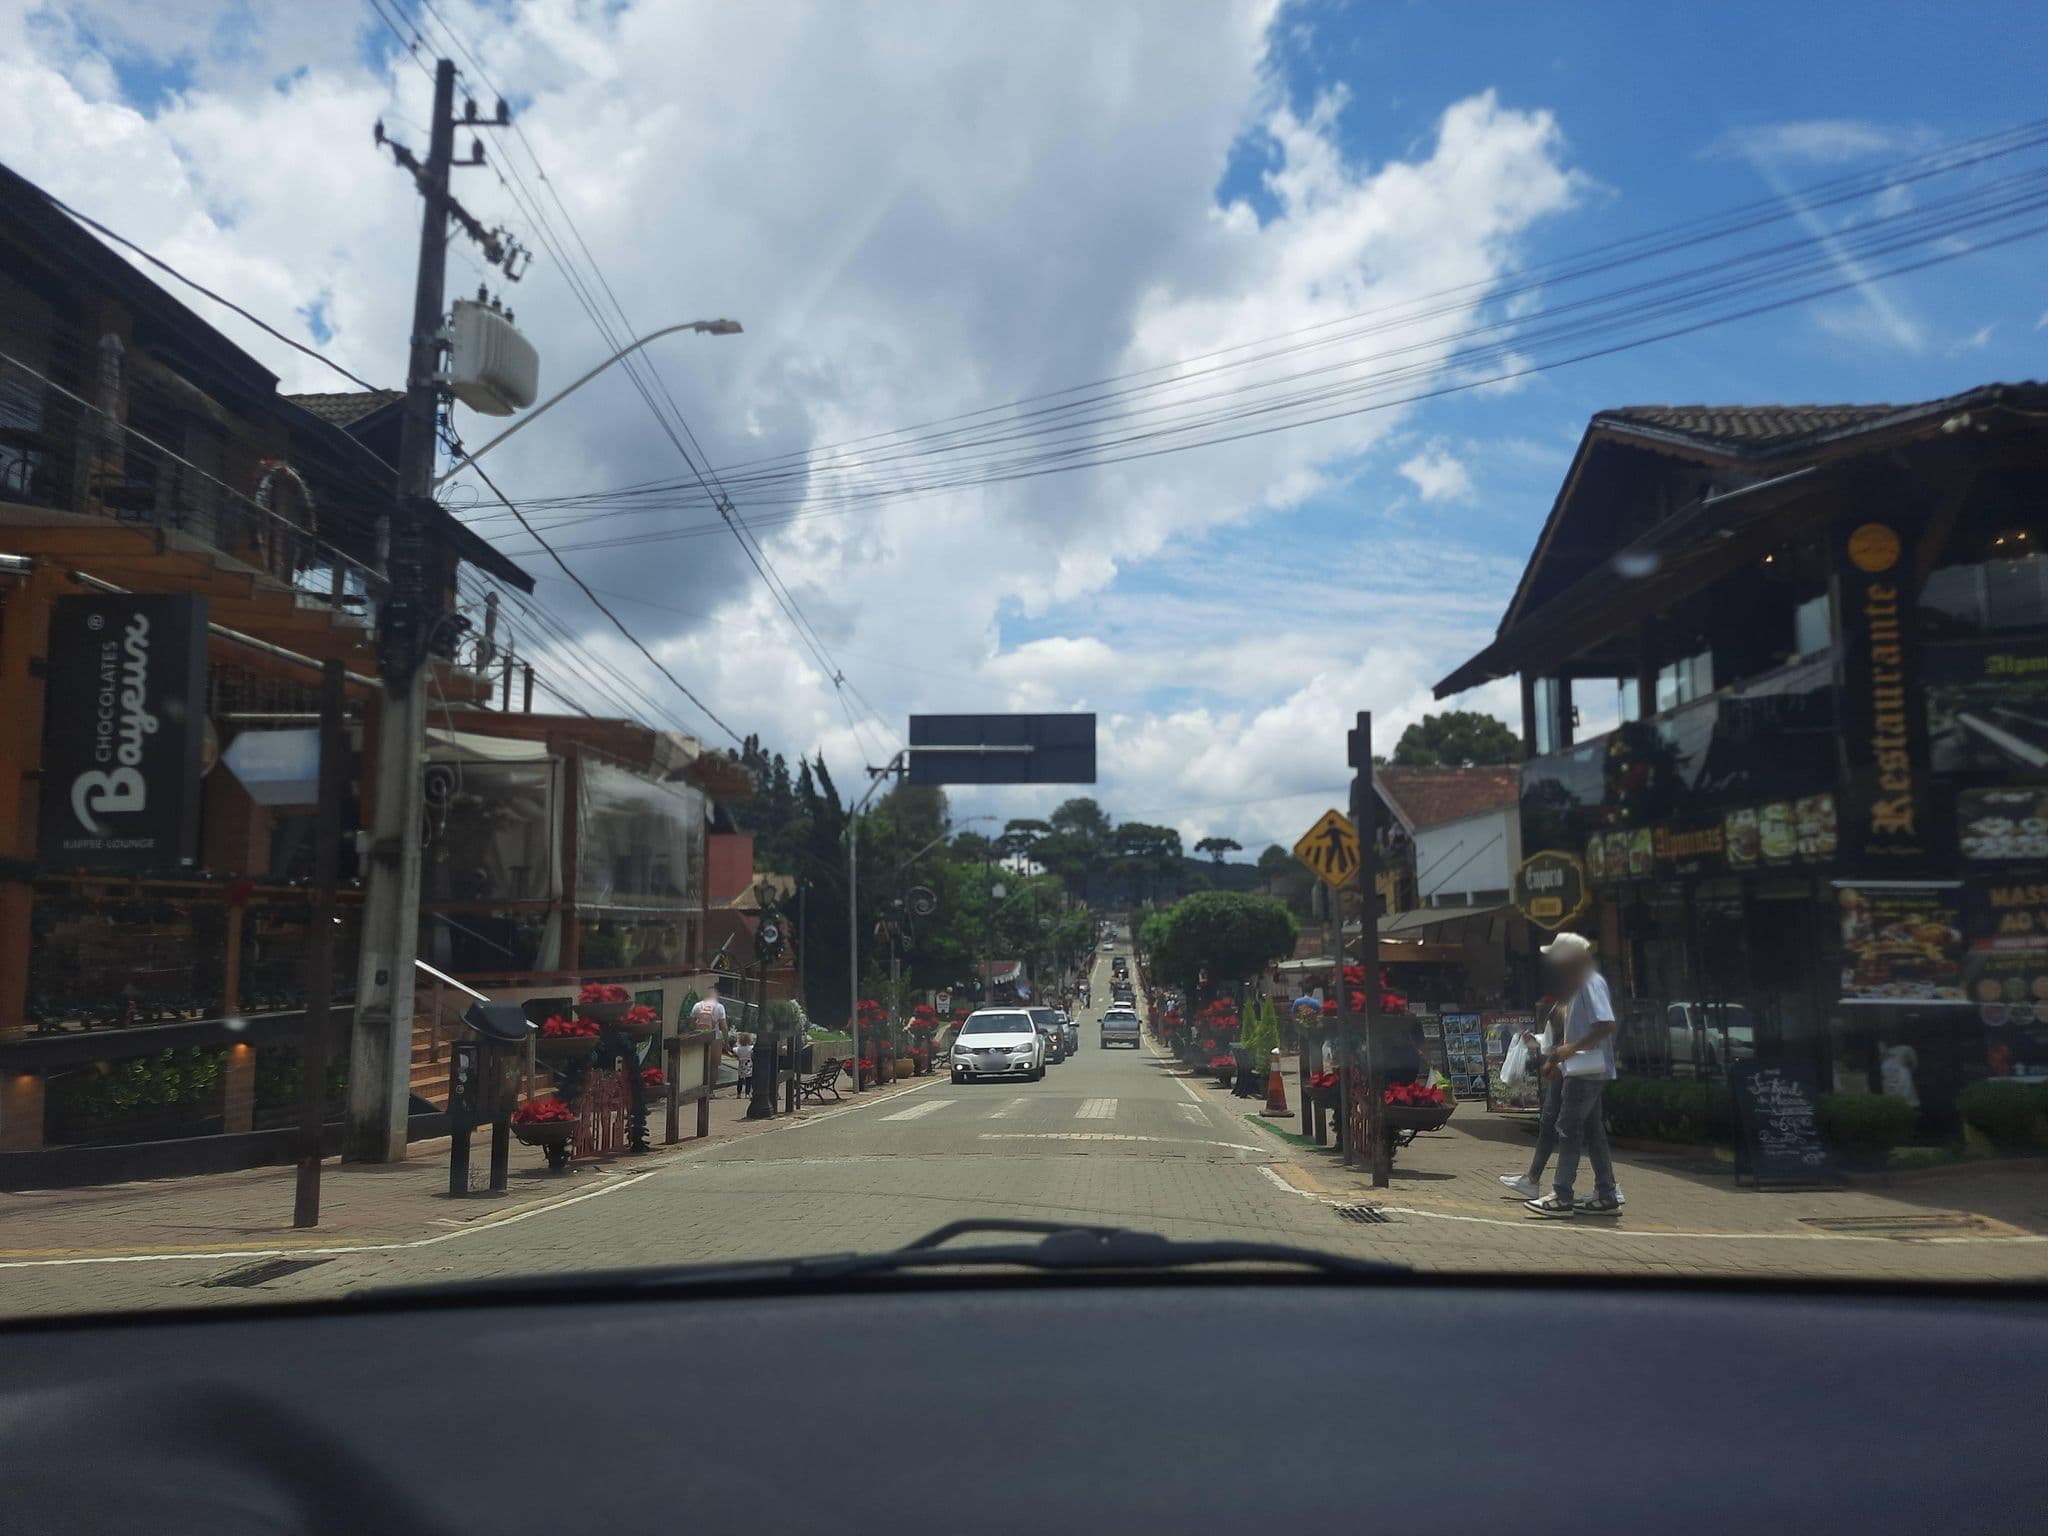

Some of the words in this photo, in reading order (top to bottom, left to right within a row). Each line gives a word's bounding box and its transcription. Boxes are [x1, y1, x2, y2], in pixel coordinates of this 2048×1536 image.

[71, 613, 159, 833] Bayeux
[94, 640, 119, 763] CHOCOLATES
[1865, 584, 1916, 835] Restaurante
